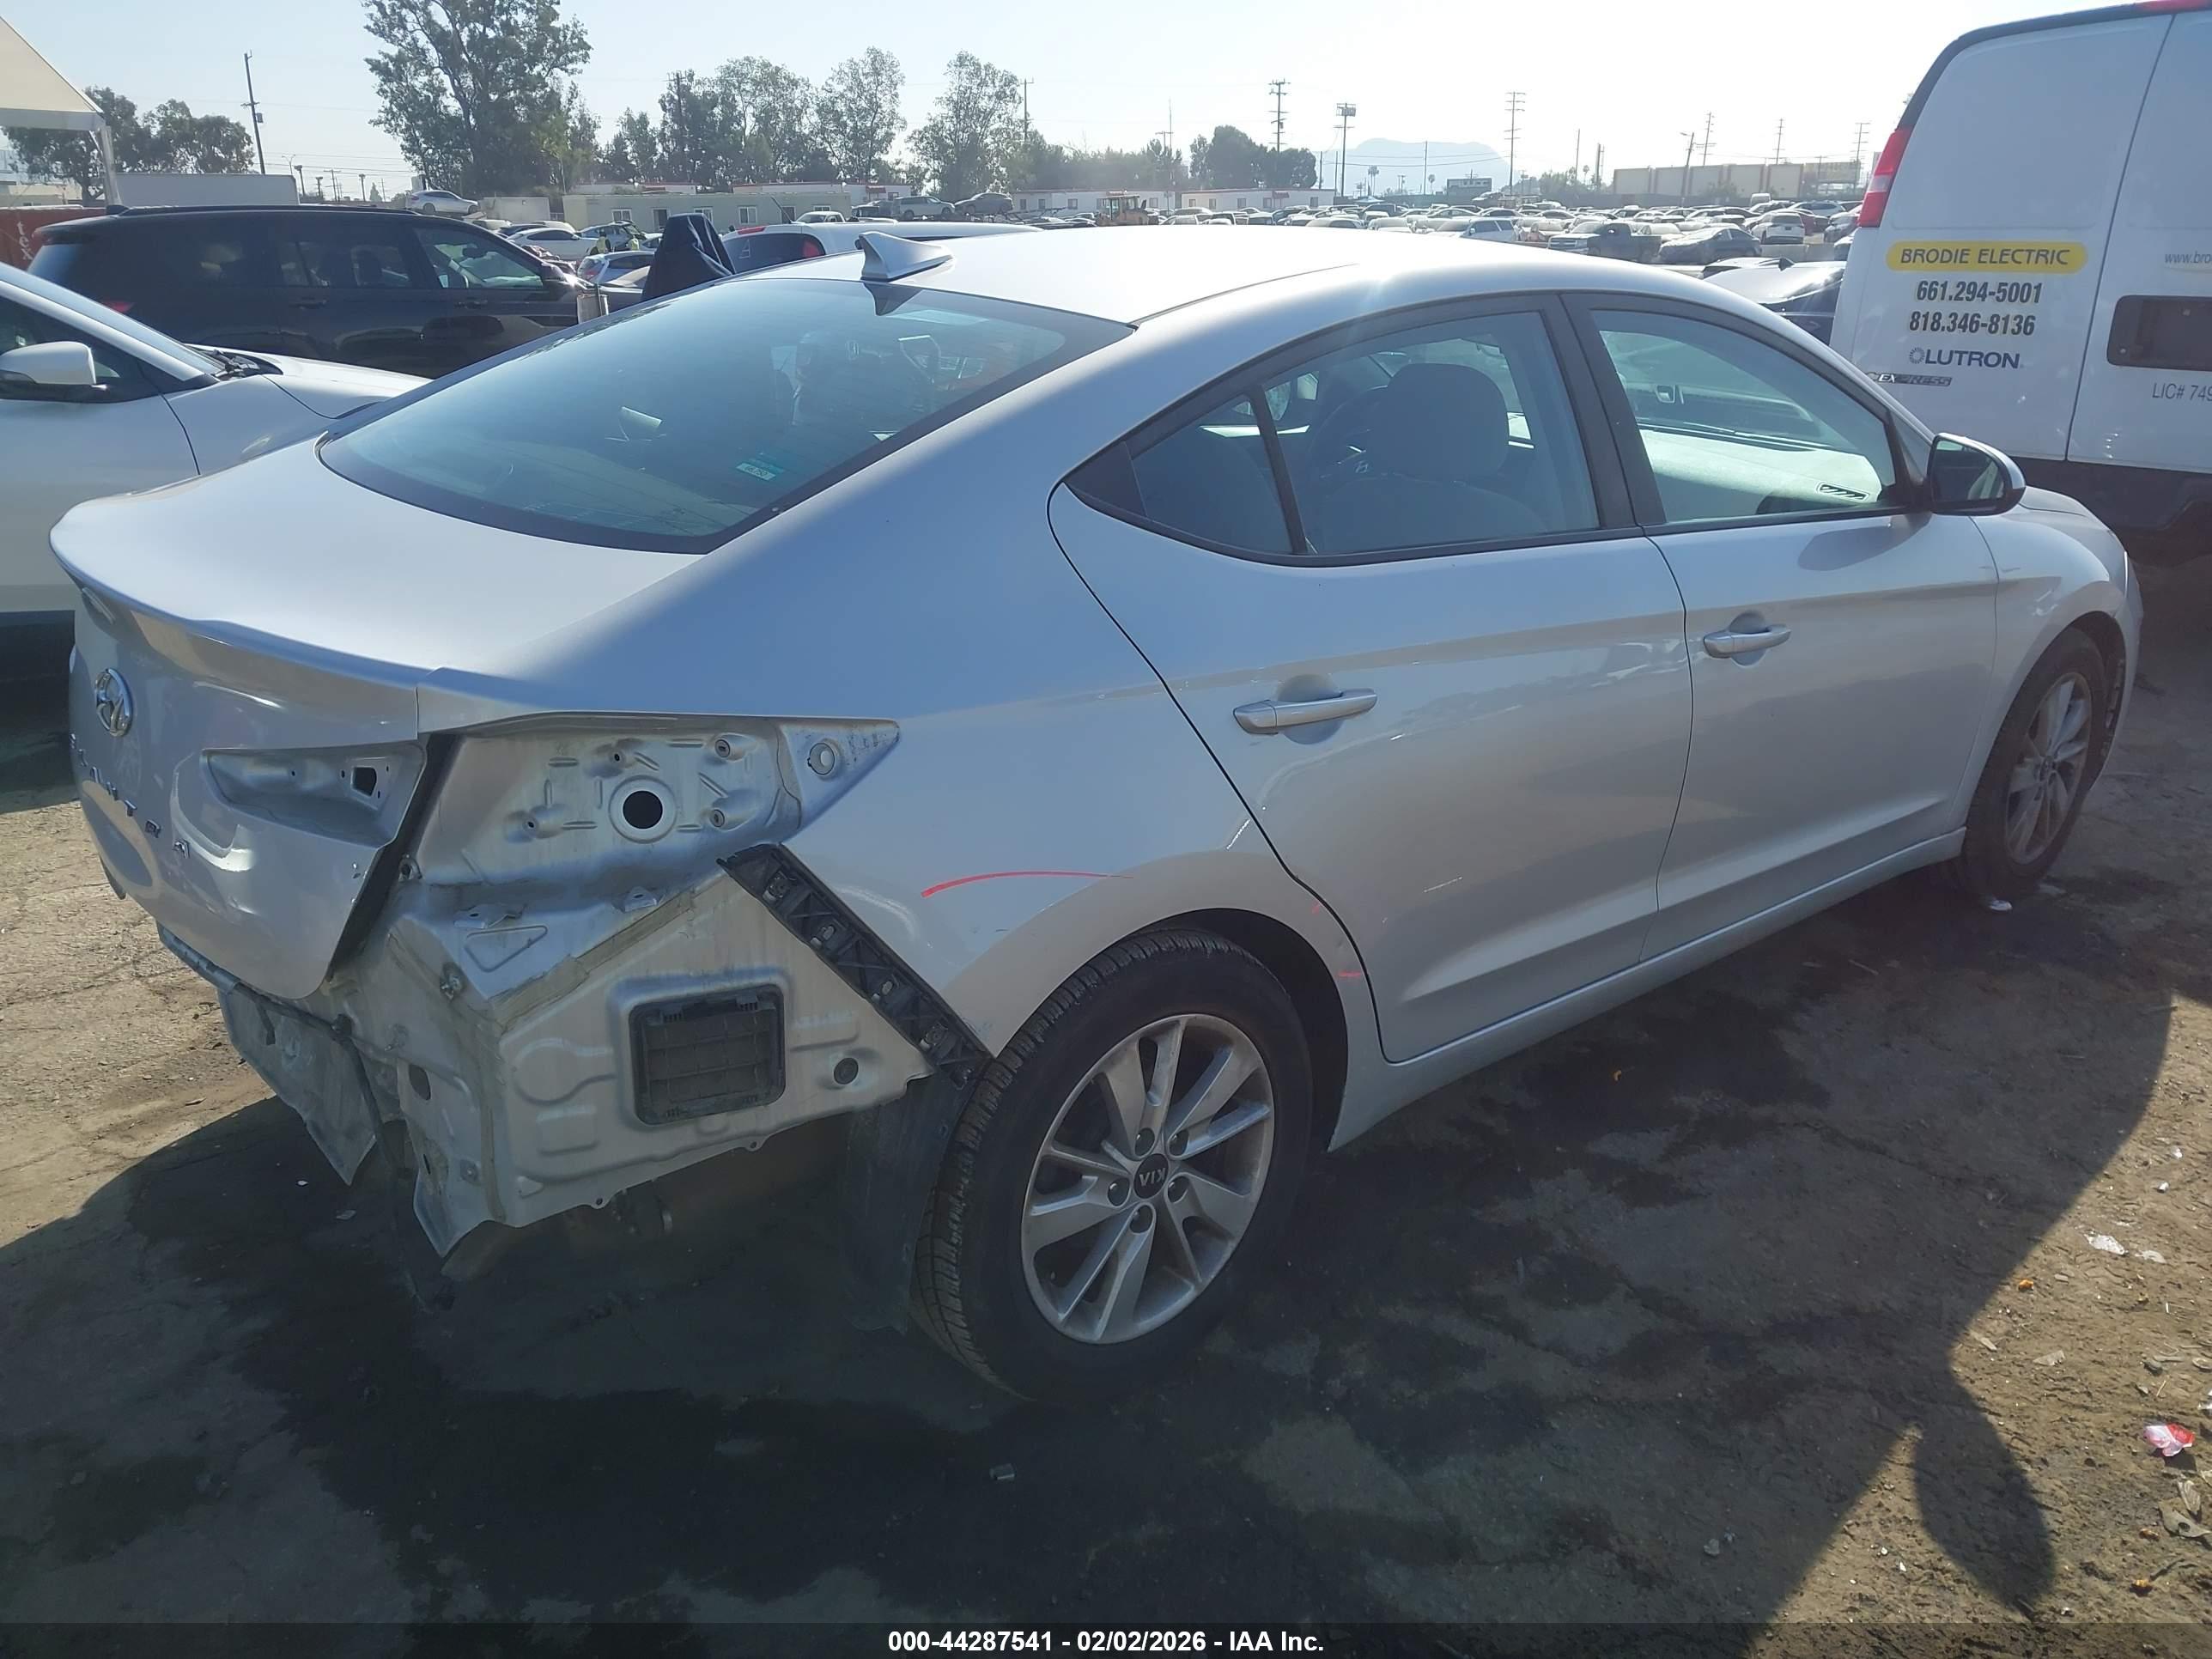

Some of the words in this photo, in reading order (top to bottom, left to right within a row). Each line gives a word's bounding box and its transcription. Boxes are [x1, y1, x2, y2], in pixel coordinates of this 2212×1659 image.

[1900, 248, 1971, 264] BRODIE
[1978, 248, 2070, 265] ELECTRIC
[1917, 280, 2043, 303] 661.294-5001
[1909, 310, 2037, 337] 818.346-8136
[1924, 349, 2021, 369] LUTRON
[2152, 382, 2185, 399] LIC#
[1139, 1168, 1166, 1187] KIA
